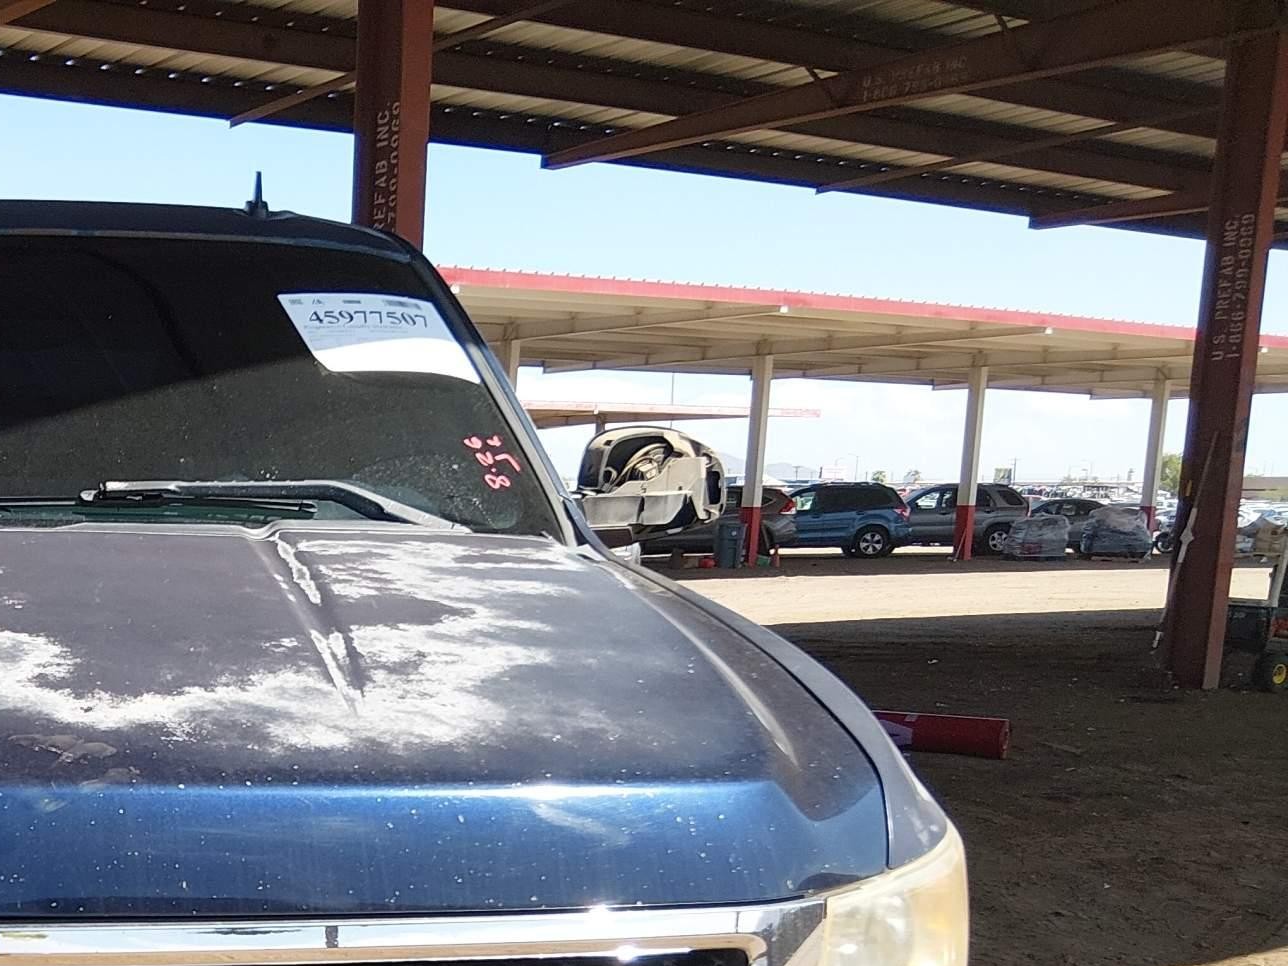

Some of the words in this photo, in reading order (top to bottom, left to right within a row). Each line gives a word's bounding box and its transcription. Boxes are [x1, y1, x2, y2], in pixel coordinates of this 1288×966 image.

[376, 101, 391, 148] INC.
[1215, 255, 1234, 320] PREFAB
[308, 309, 429, 329] 45977507
